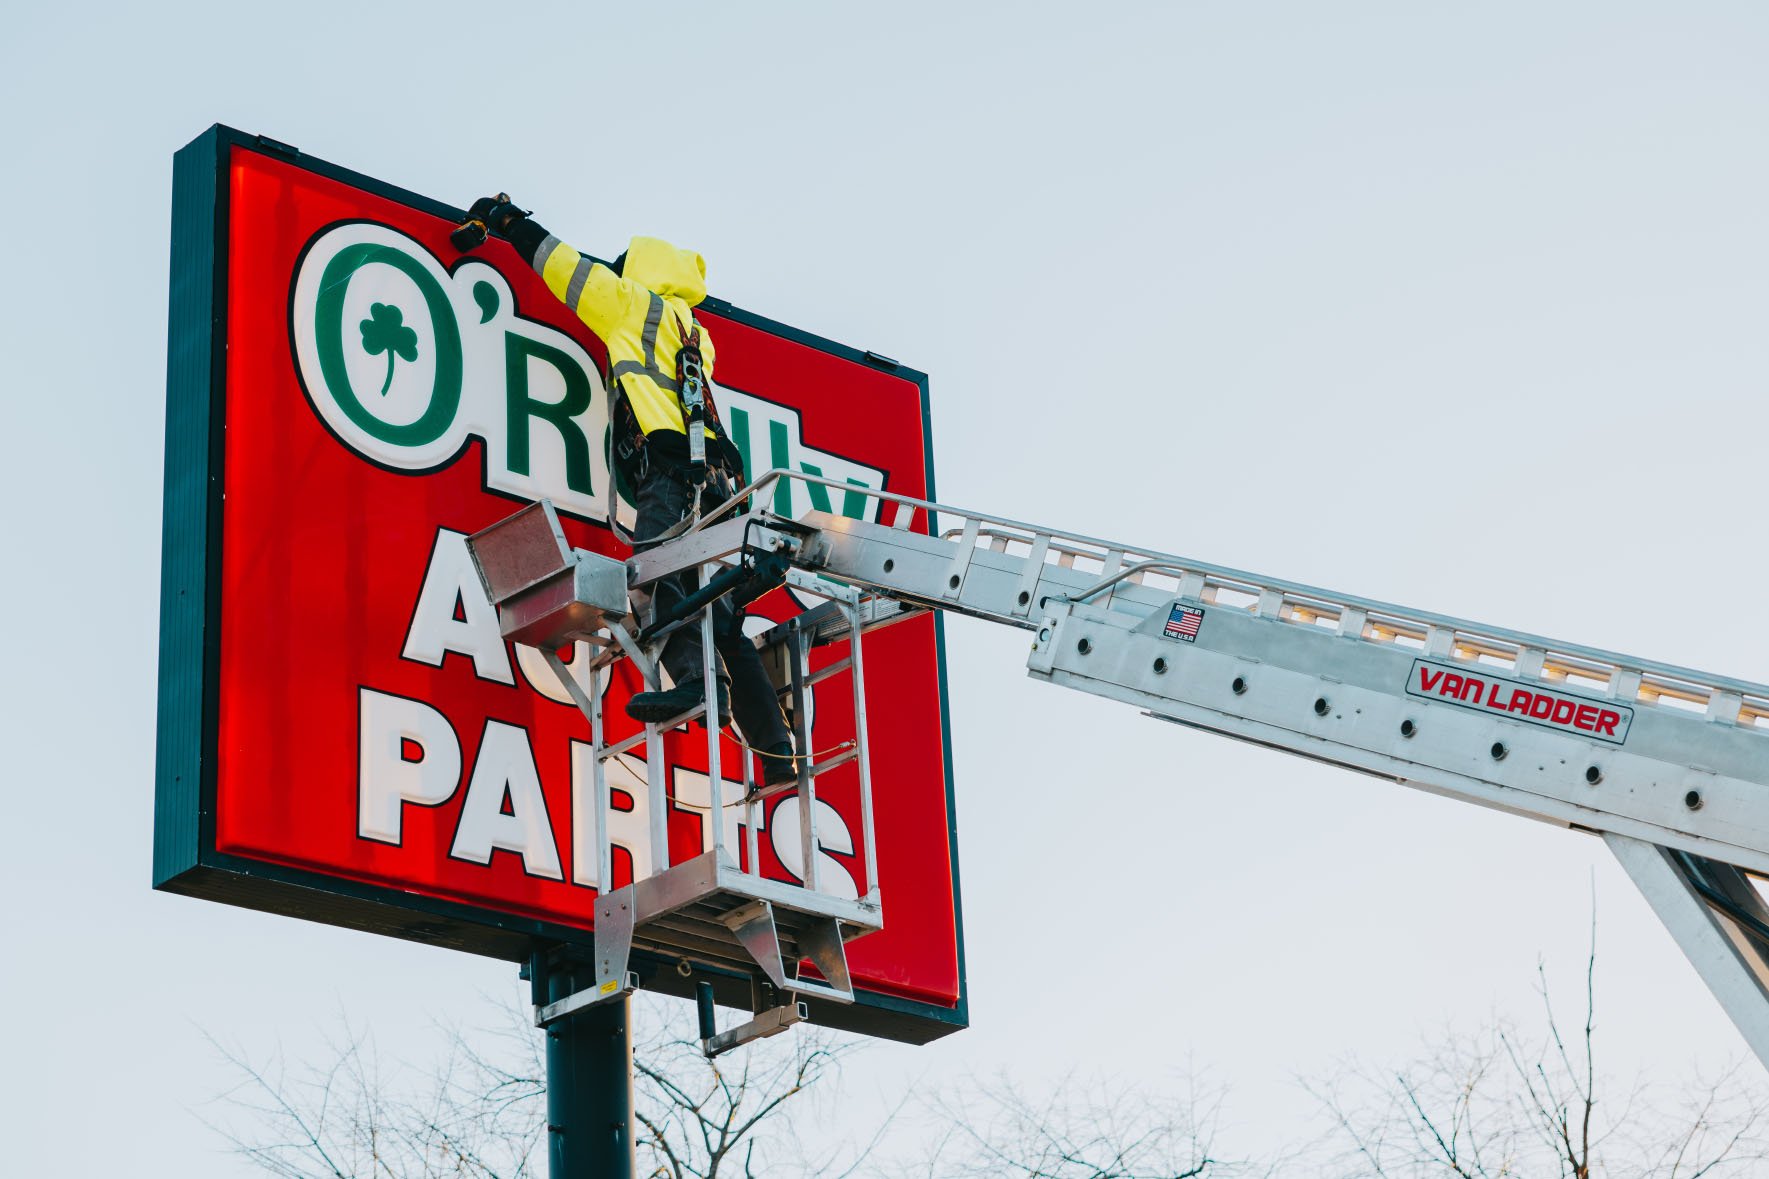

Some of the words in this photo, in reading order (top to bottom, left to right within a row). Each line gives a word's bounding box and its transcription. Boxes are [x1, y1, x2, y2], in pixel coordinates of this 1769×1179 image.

[1175, 604, 1195, 614] MADE
[1165, 629, 1179, 638] THE
[1420, 667, 1485, 704] VAN
[1486, 684, 1621, 736] LADDER
[358, 687, 858, 899] PARTS
